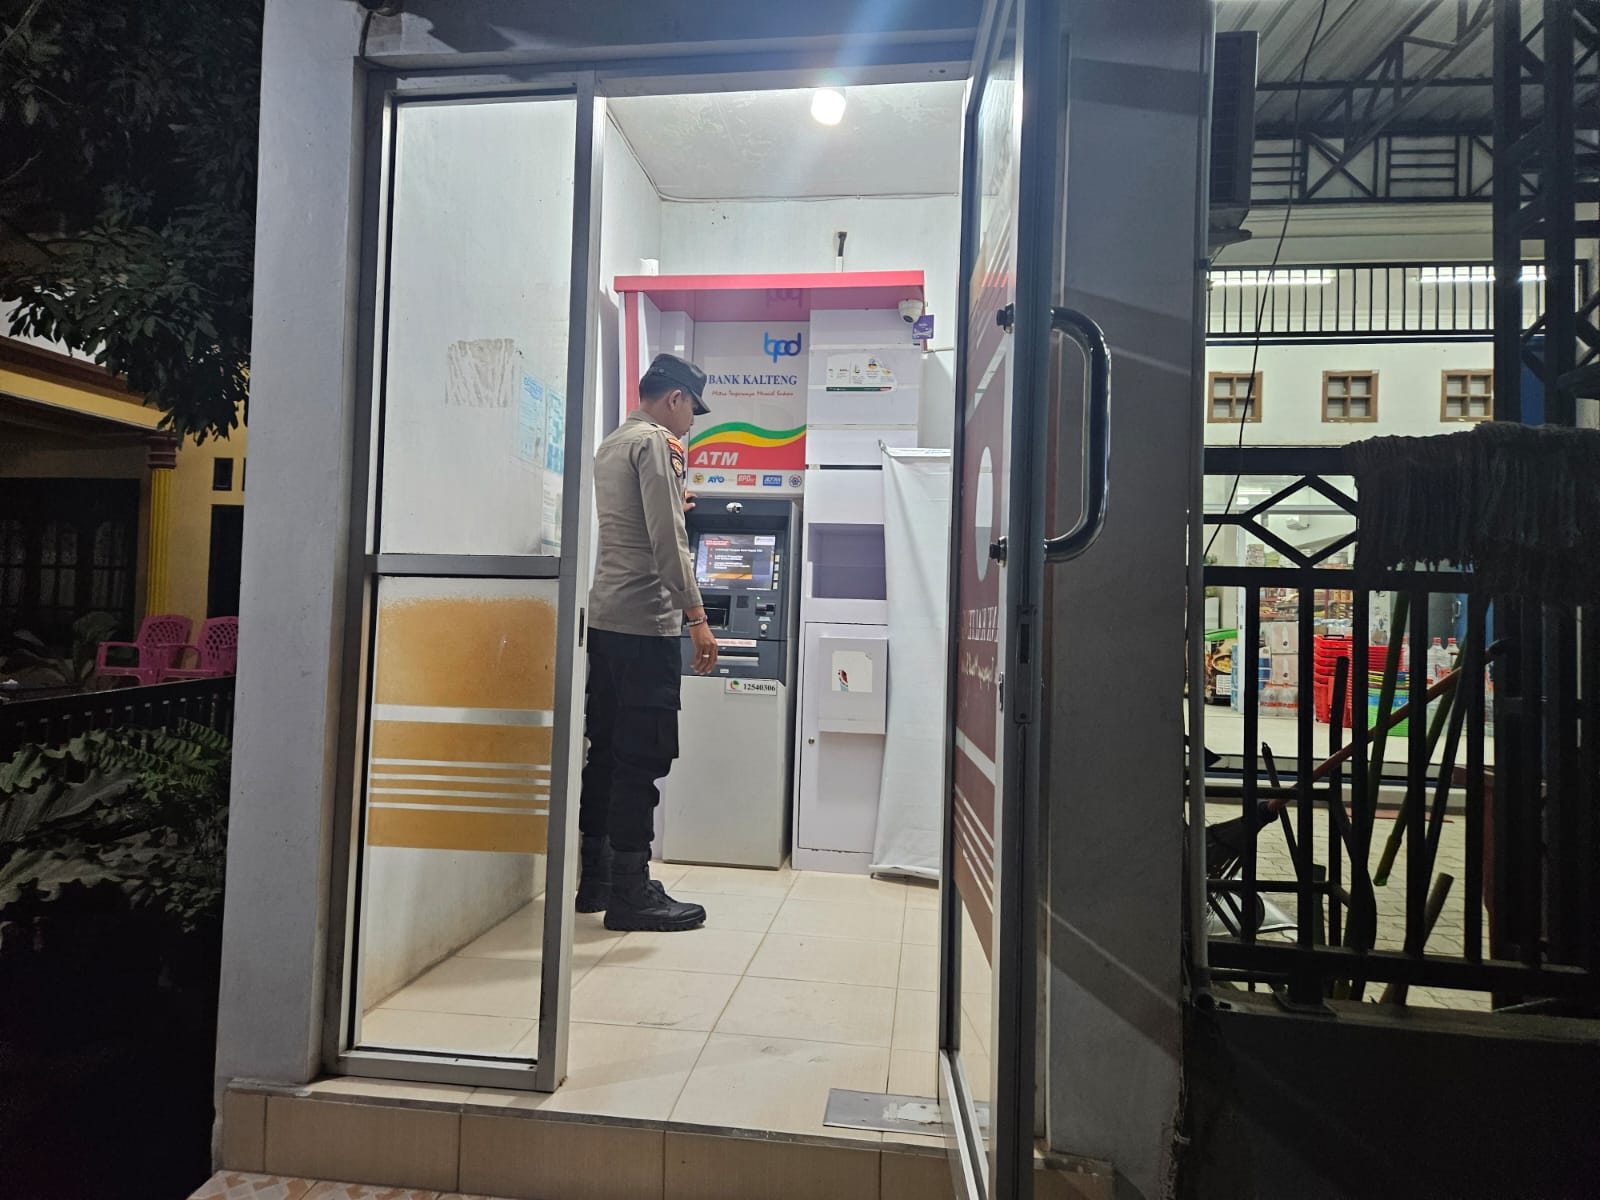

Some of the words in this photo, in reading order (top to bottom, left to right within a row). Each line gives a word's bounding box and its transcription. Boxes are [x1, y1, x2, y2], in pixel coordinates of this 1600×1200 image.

[763, 331, 802, 364] bpd
[708, 374, 740, 385] BANK
[743, 374, 798, 386] KALTENG
[694, 451, 739, 466] ATM
[743, 683, 776, 692] 12540306
